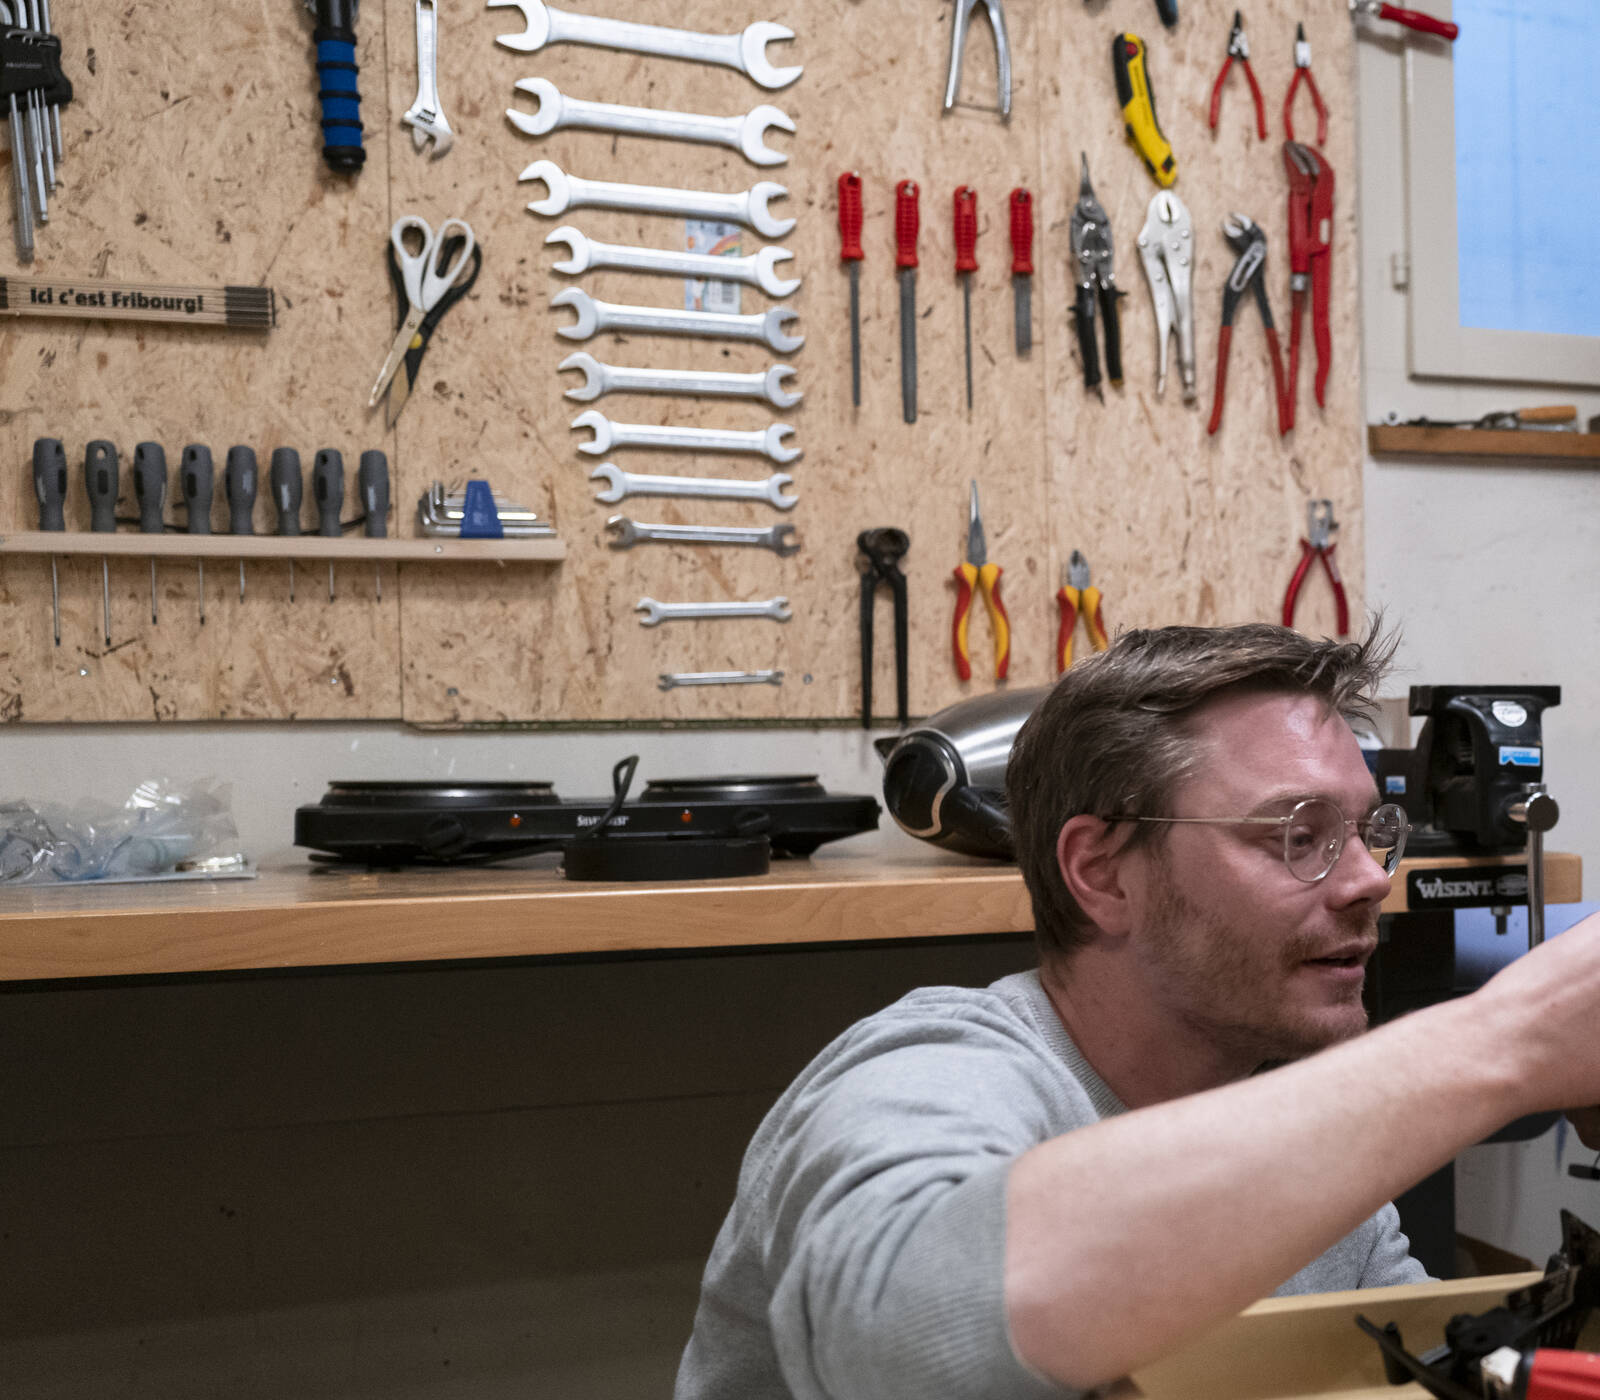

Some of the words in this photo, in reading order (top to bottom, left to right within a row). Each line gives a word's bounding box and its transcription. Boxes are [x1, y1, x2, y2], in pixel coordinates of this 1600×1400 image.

[30, 286, 53, 305] Ici
[59, 288, 107, 308] c'est
[112, 291, 204, 314] Fribourg!
